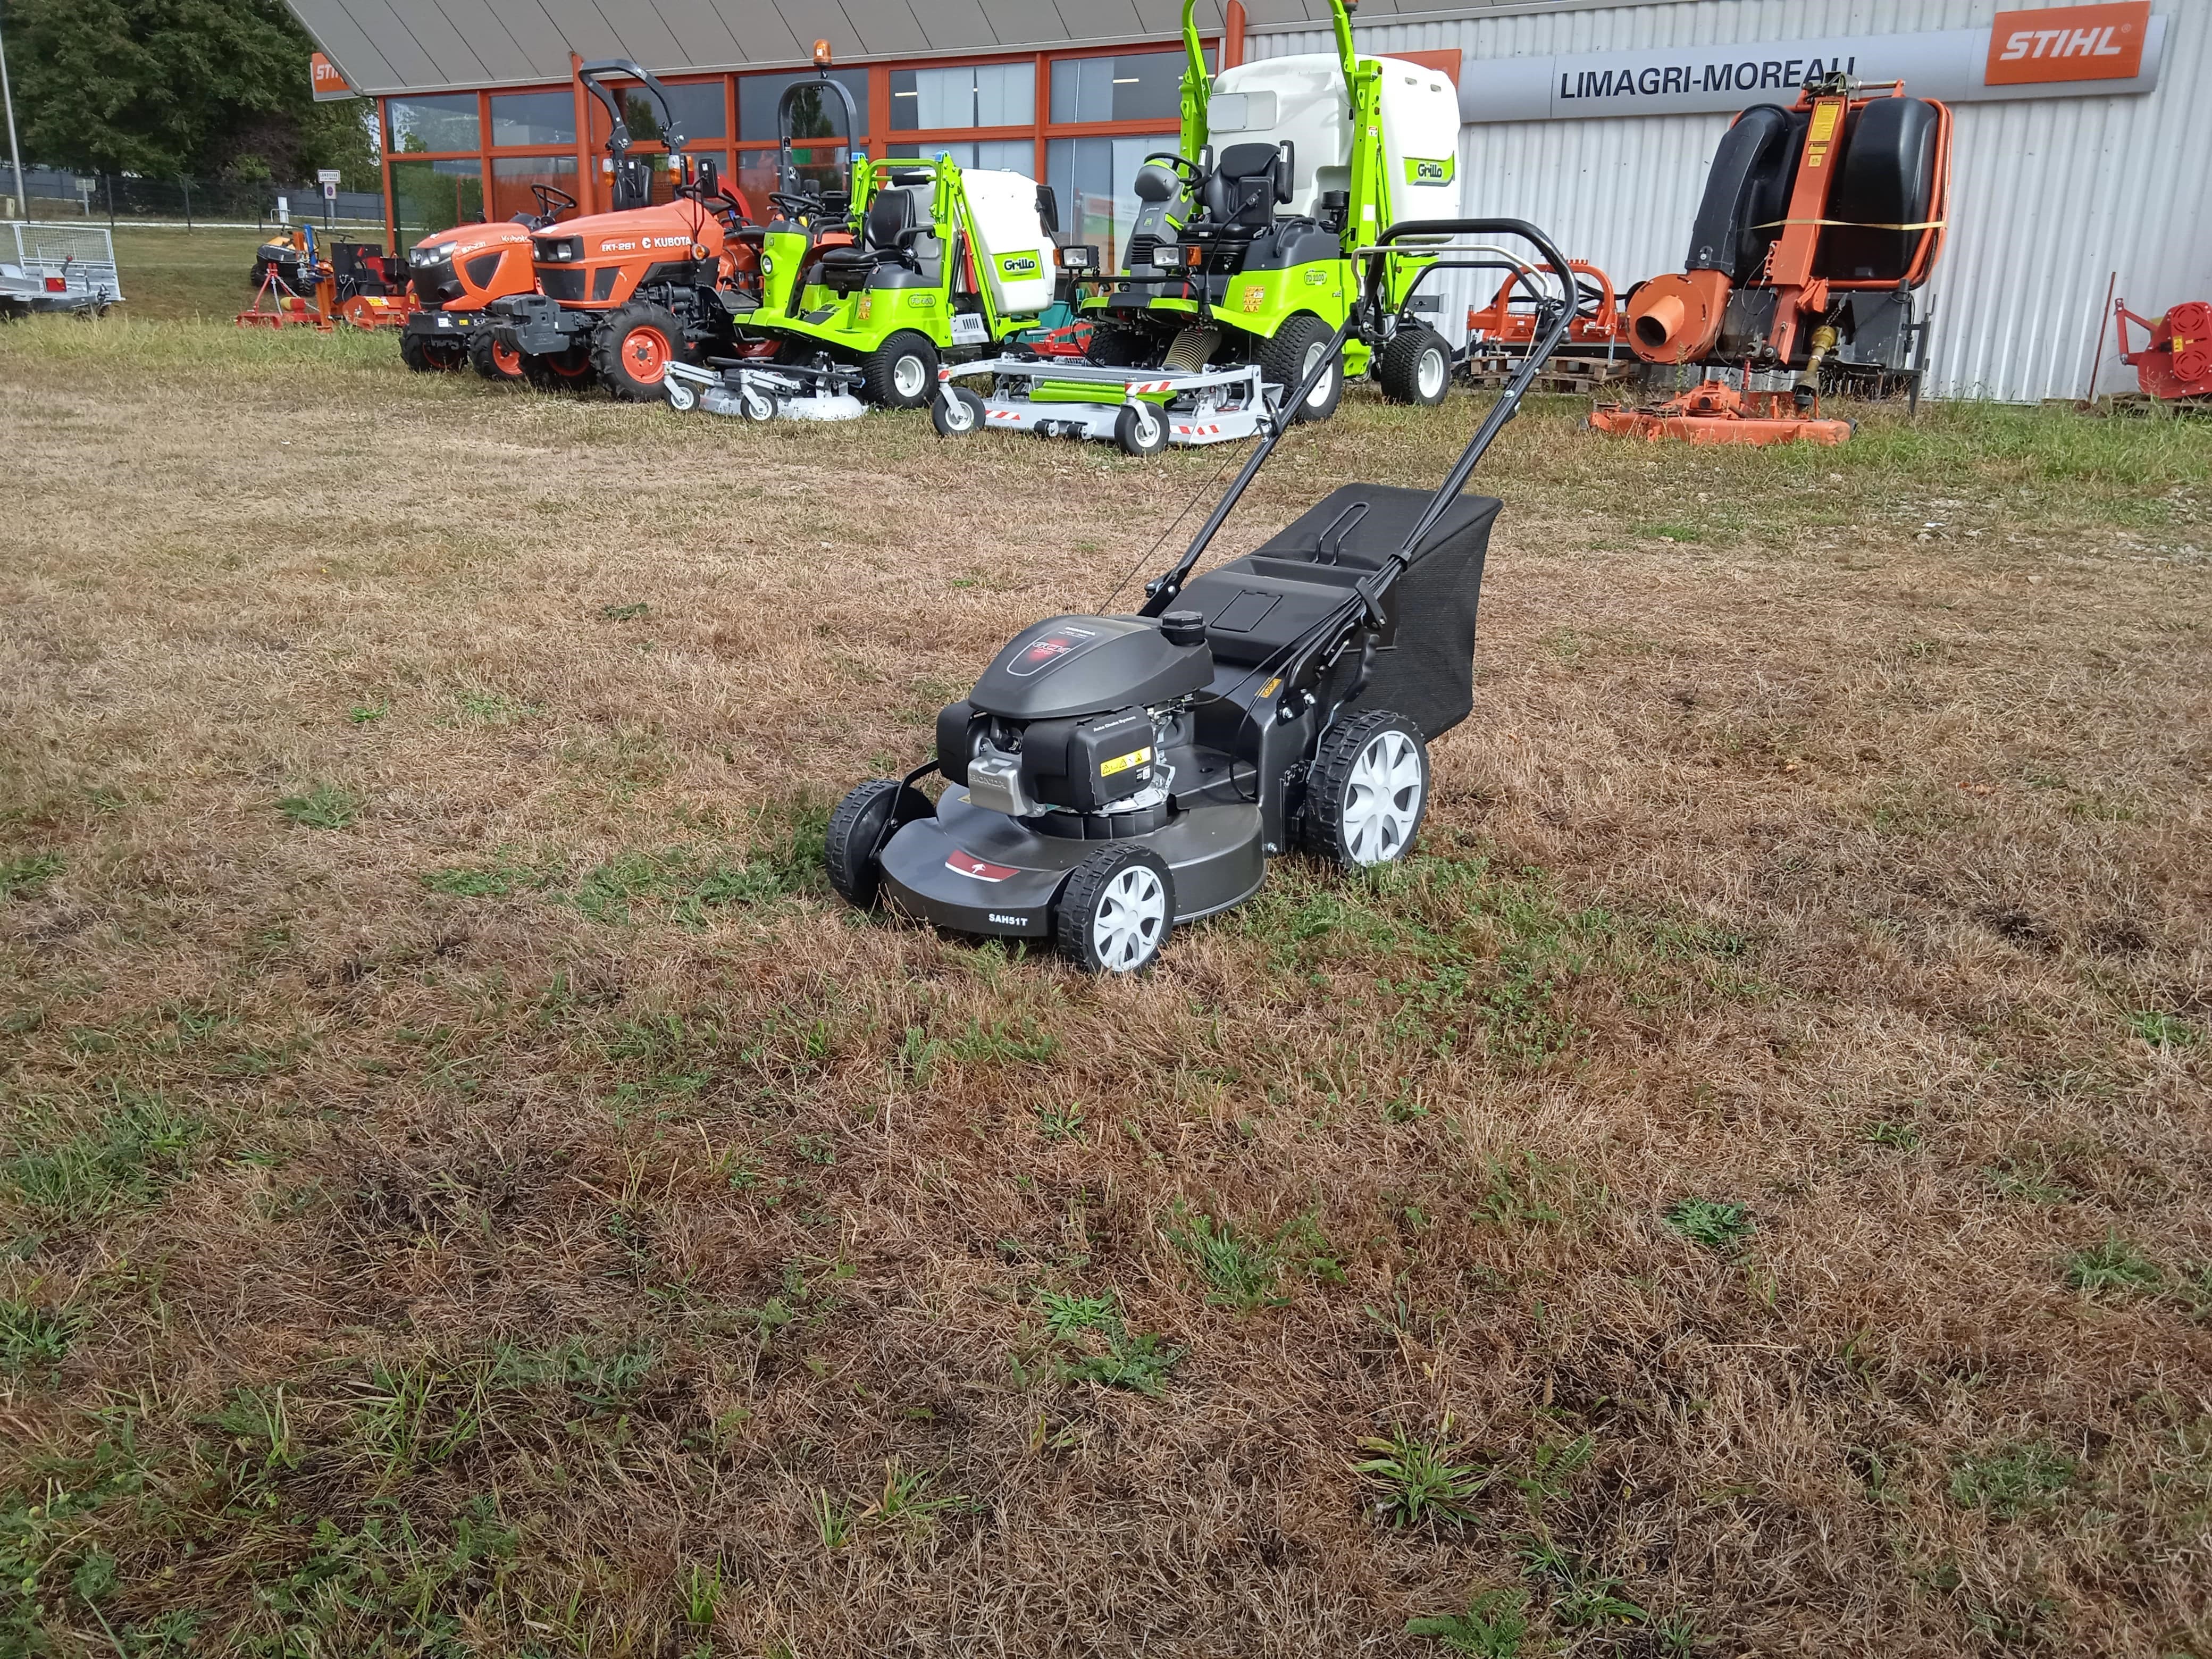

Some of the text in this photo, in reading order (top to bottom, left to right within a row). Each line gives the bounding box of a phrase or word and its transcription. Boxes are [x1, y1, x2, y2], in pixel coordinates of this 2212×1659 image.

[1999, 27, 2122, 60] STIHL
[1418, 163, 1442, 178] Grillo
[654, 236, 692, 248] KUBOTA
[1004, 258, 1035, 270] Grillo
[988, 913, 1028, 926] SAH51T
